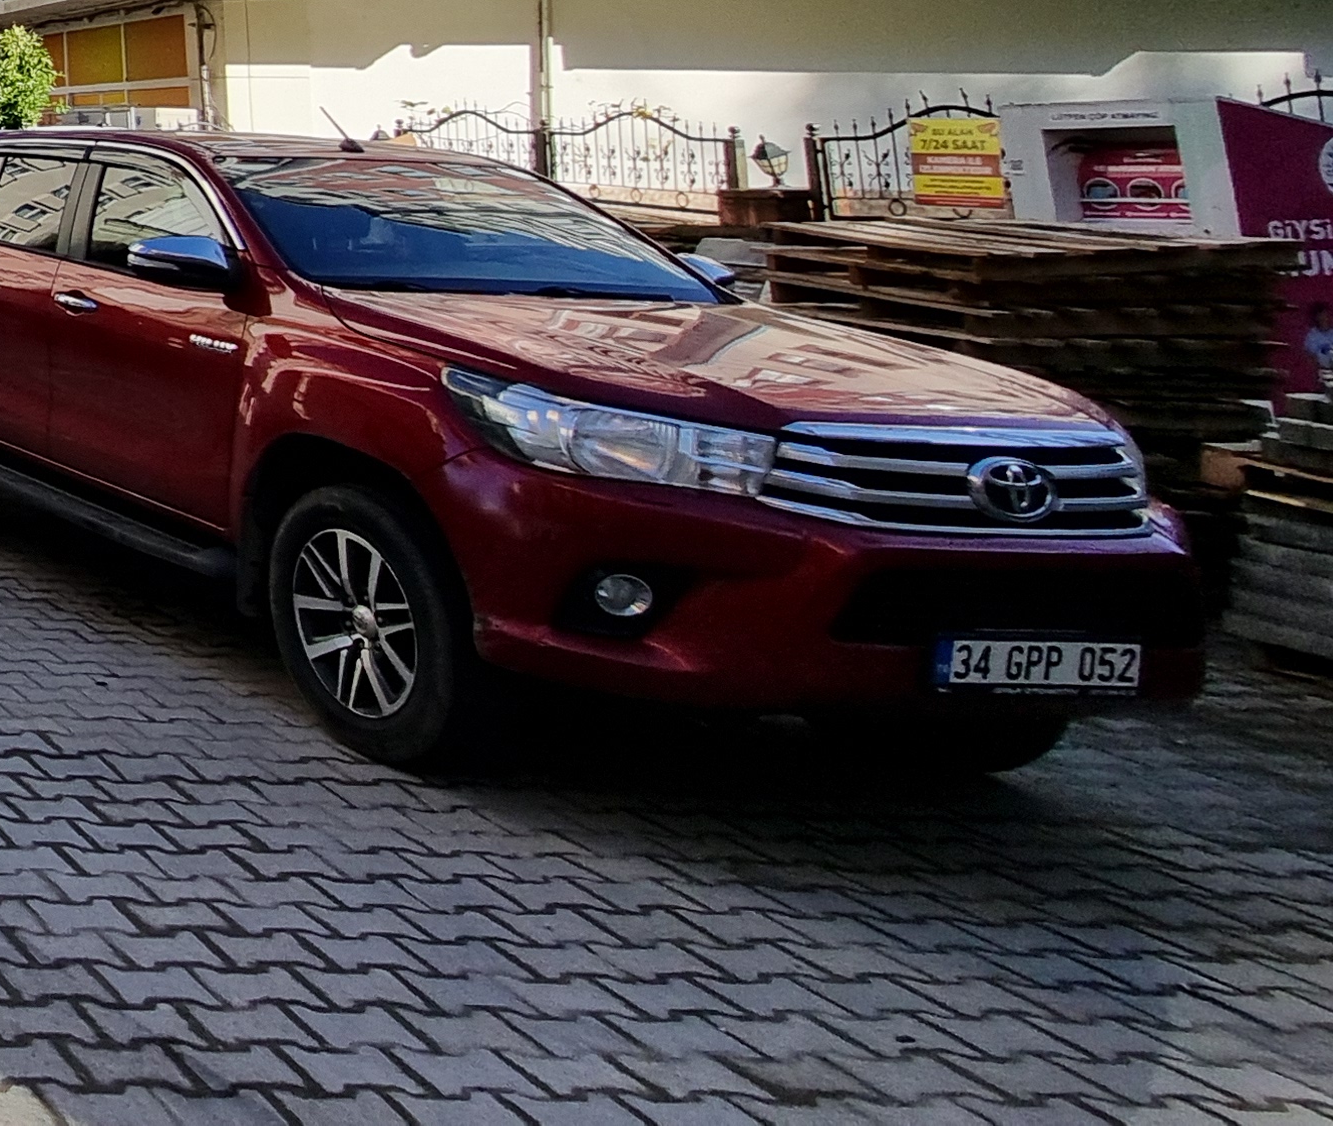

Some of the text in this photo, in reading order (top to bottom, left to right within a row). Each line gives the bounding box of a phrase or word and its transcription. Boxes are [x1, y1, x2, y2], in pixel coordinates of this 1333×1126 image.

[920, 139, 986, 151] 7/24 SAAT
[953, 644, 992, 680] 34
[1005, 645, 1063, 681] GPP
[1078, 647, 1137, 683] 052
